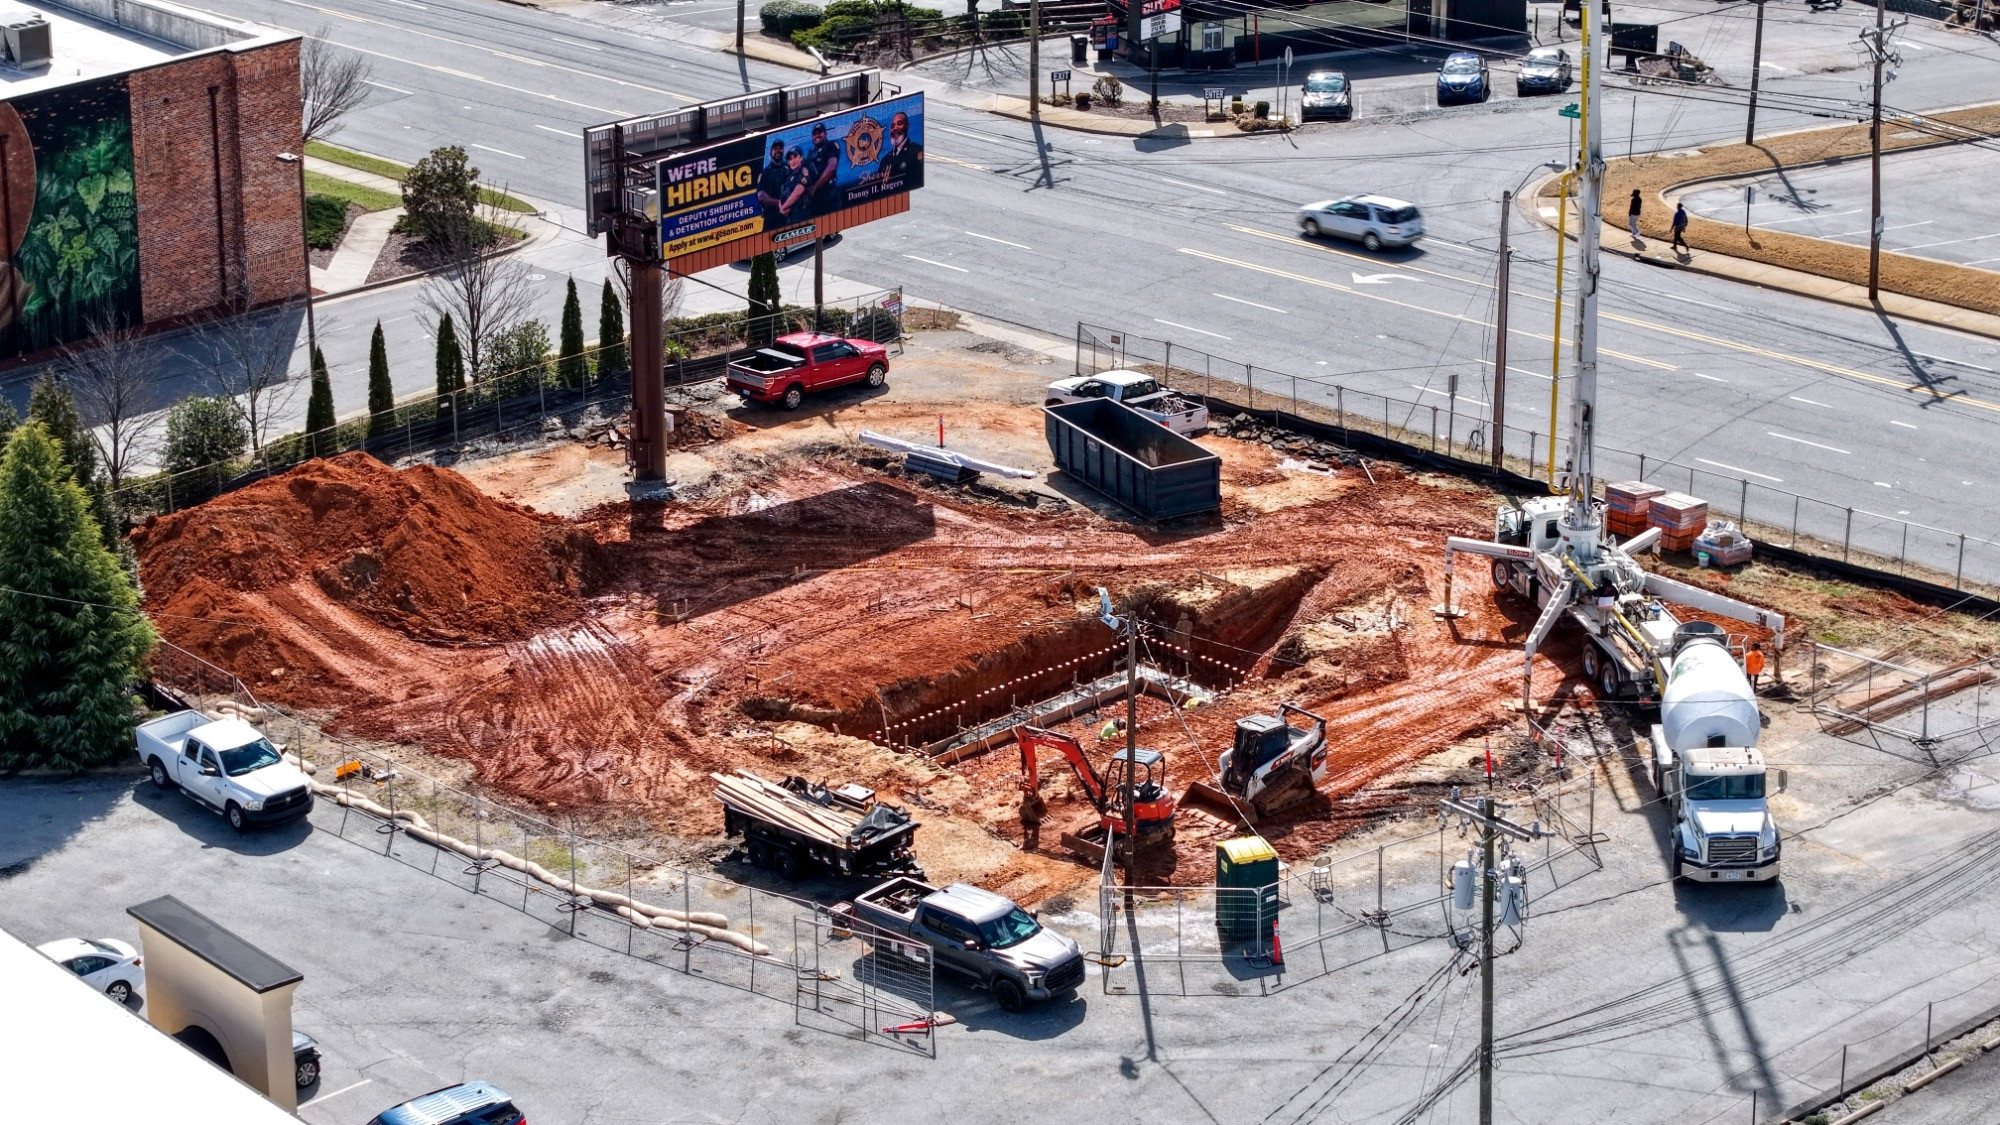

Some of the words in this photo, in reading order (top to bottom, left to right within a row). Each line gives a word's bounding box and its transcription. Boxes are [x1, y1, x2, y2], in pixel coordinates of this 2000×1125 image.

[1053, 71, 1070, 80] EXIT
[1205, 90, 1223, 99] ENTER
[668, 157, 717, 182] WE'RE
[667, 166, 752, 207] HIRING
[848, 189, 869, 200] Danny
[881, 180, 904, 192] Rogers
[675, 217, 717, 235] DETENTION
[718, 206, 754, 222] OFFICERS
[679, 210, 708, 225] DEPUTY
[709, 200, 744, 216] SHERIFFS
[778, 225, 813, 241] LAMAR
[669, 241, 688, 253] Apply
